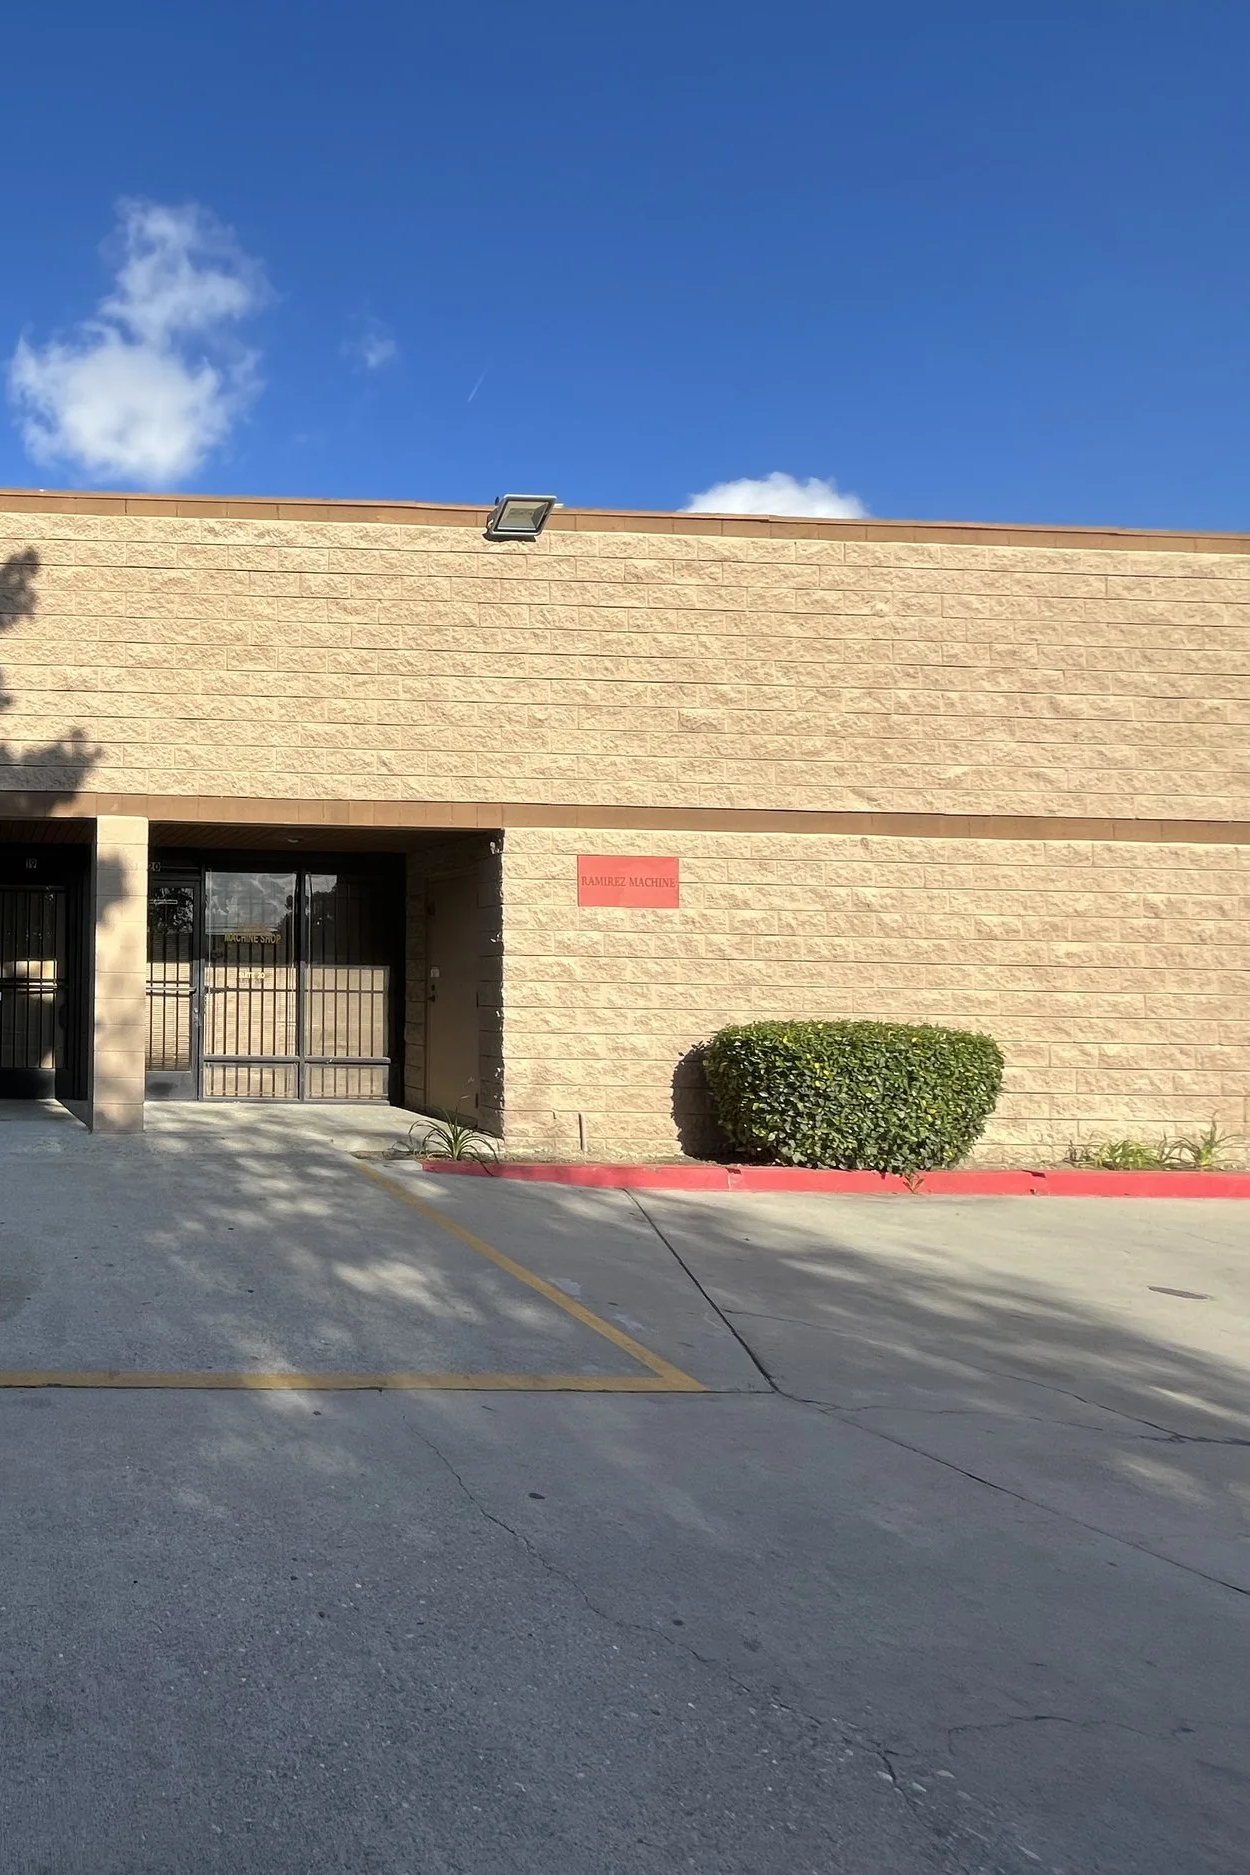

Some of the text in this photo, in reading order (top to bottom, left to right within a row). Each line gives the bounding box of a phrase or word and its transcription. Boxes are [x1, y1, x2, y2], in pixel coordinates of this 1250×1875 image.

[581, 876, 676, 887] RAMIREZ MACHINE
[224, 933, 281, 944] MACHINE SHOP
[239, 971, 265, 979] SUITE 20
